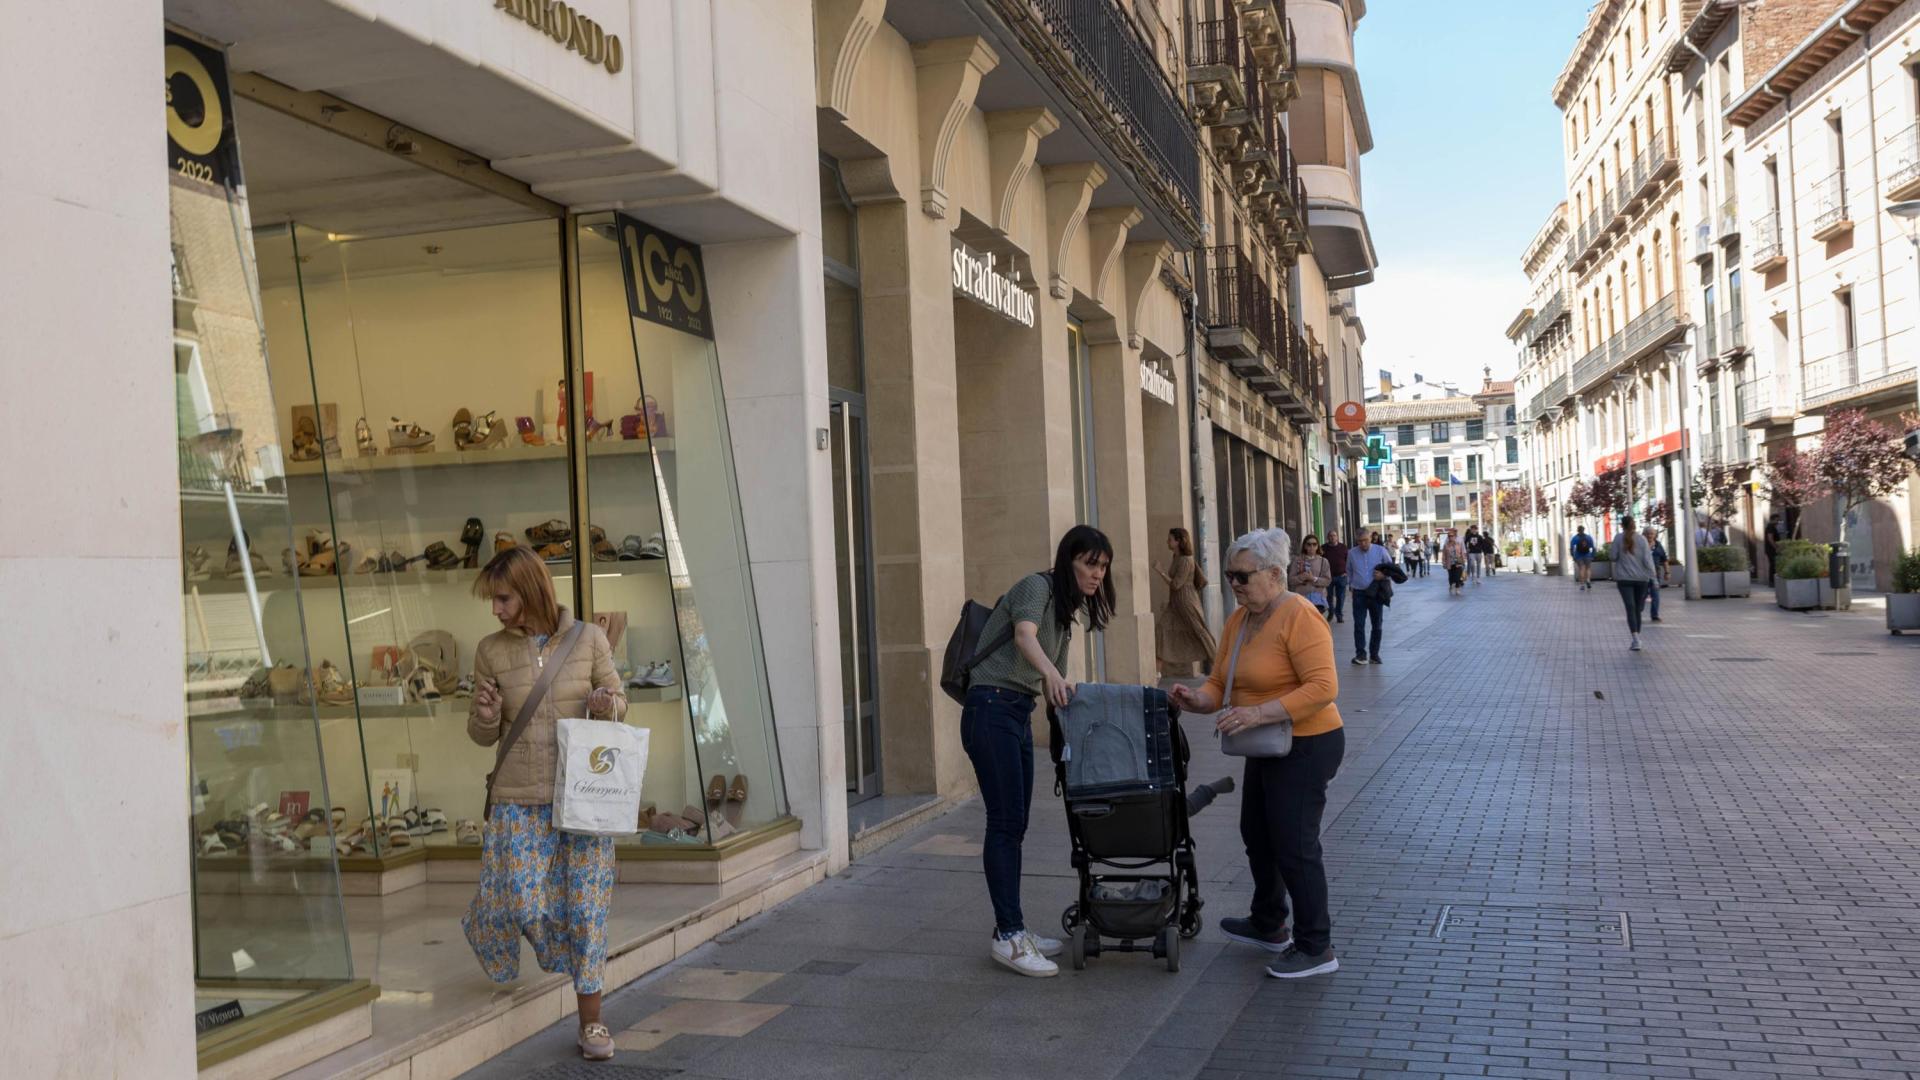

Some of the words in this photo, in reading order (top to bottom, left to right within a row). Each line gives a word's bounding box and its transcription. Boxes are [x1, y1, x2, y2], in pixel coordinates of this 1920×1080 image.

[177, 157, 215, 186] 2022
[624, 225, 703, 314] 100
[953, 243, 1035, 328] stradivarius
